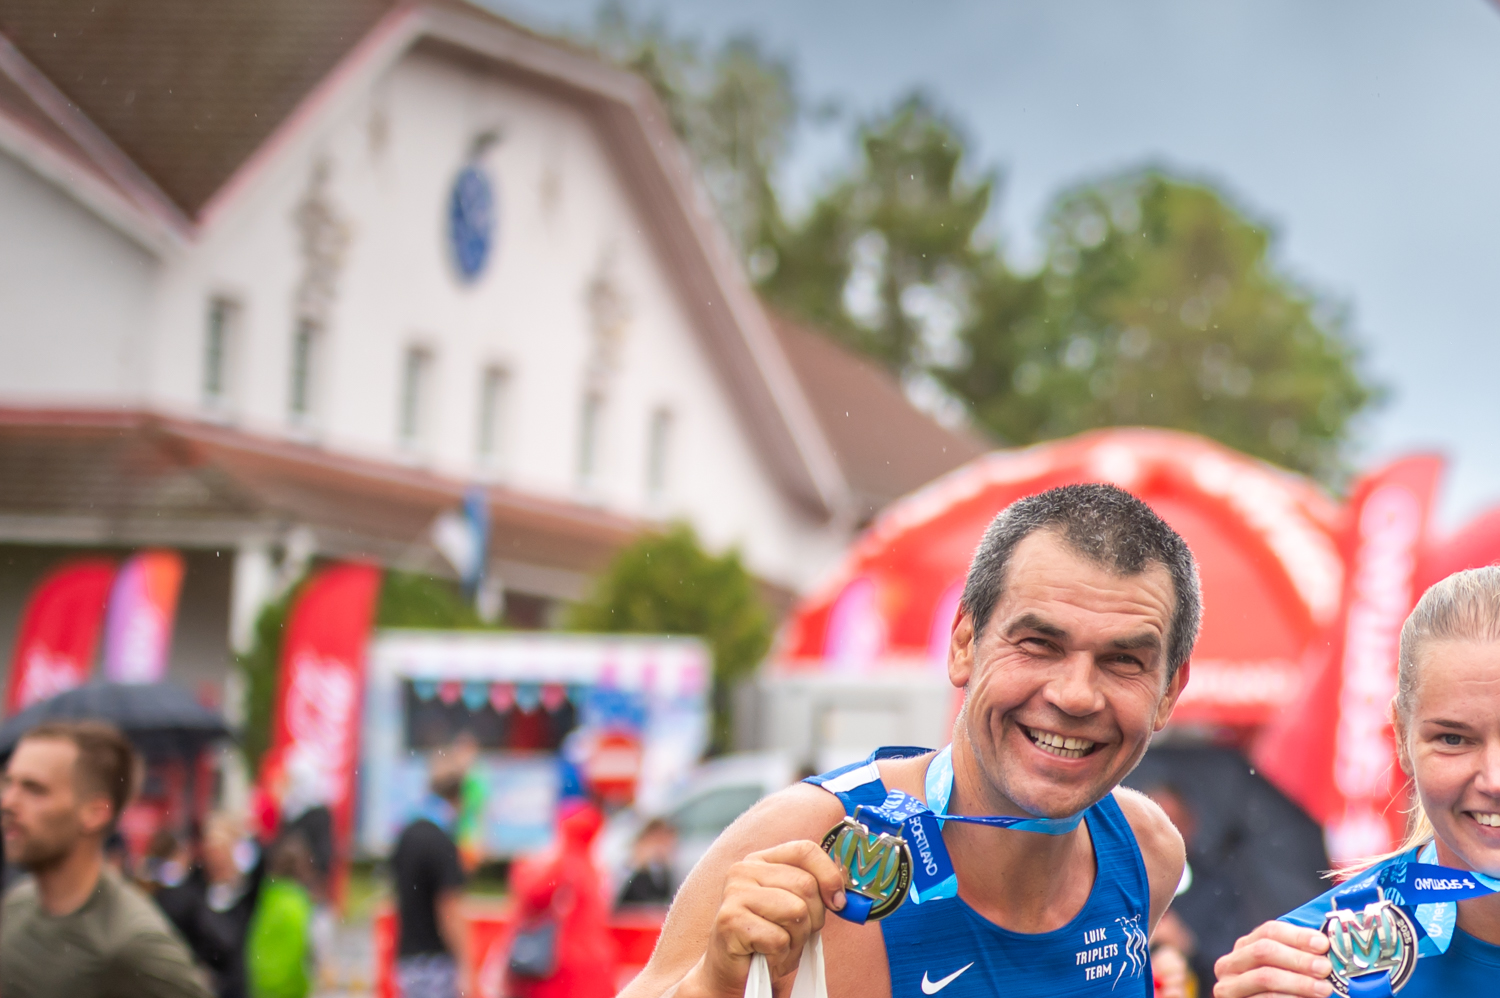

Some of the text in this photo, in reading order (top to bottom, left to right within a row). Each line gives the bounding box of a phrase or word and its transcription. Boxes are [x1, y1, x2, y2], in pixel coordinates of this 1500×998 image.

[1414, 878, 1463, 890] SPORTLAND
[1084, 927, 1107, 945] LUIK
[1075, 943, 1119, 966] TRIPLETS
[1085, 962, 1112, 981] TEAM
